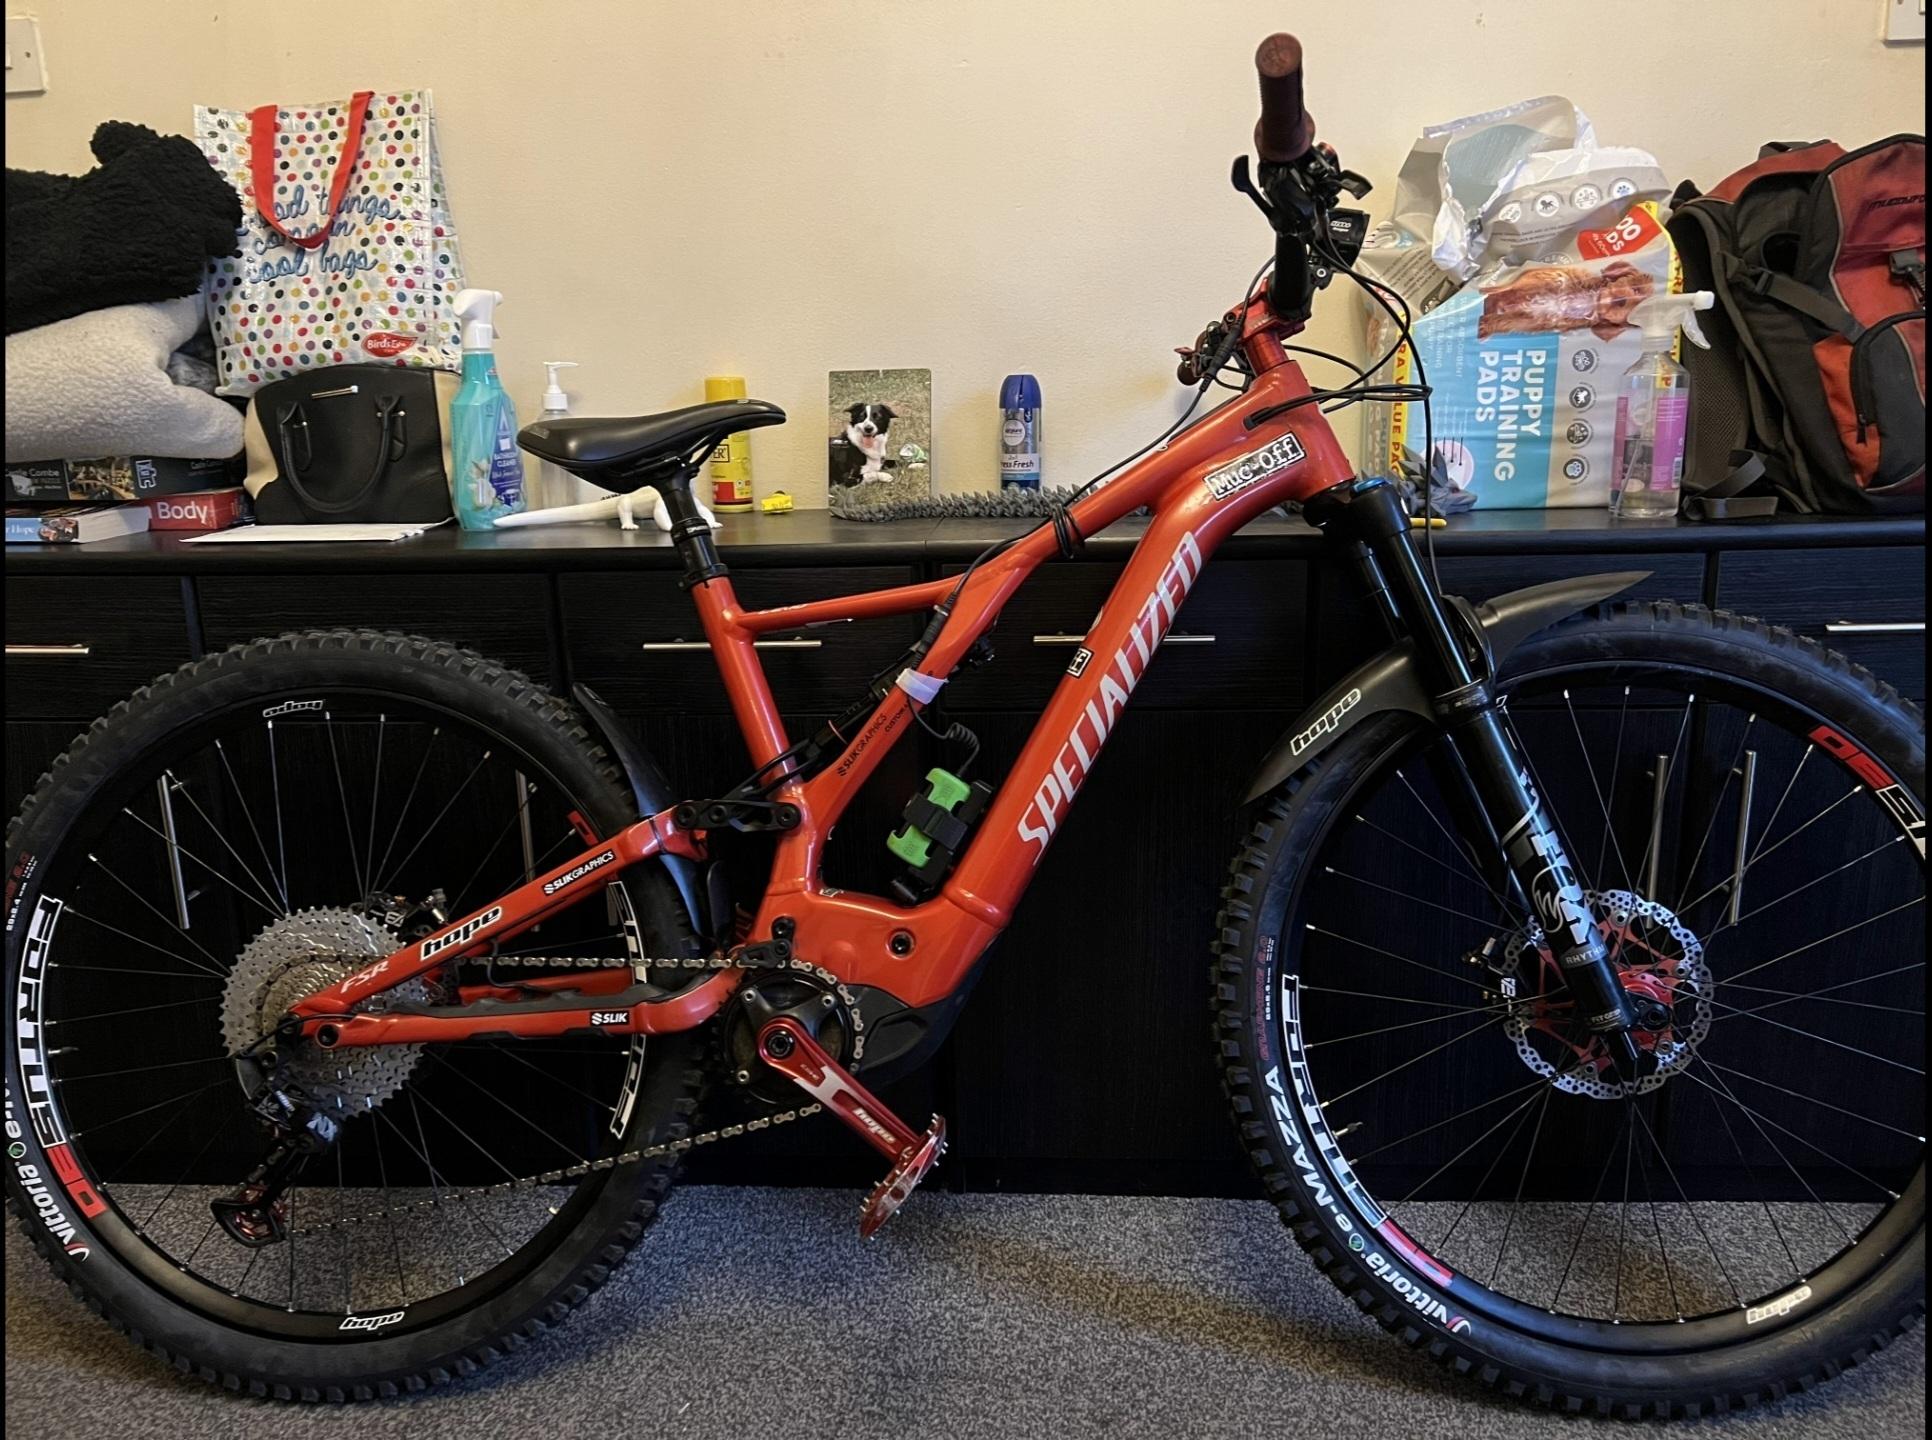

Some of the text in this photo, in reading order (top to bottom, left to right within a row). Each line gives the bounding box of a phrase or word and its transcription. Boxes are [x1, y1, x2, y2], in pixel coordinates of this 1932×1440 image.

[1475, 351, 1499, 422] PADS
[1493, 349, 1523, 481] TRAINING
[1520, 350, 1547, 437] PUPPY
[1211, 437, 1297, 494] Muc-Off
[156, 501, 208, 525] Body
[262, 700, 323, 717] hope
[1017, 531, 1202, 867] SPECIALIZED
[1290, 688, 1361, 756] hope
[552, 851, 614, 890] SLIKGRAPHICS
[420, 906, 502, 961] hope
[340, 960, 389, 994] FSR
[602, 1012, 627, 1024] SLIK
[17, 895, 107, 1219] FORTUS 30
[852, 1106, 896, 1145] hope
[1282, 973, 1388, 1229] FORTUS
[1265, 1064, 1355, 1234] e-MAZZA
[17, 1162, 78, 1246] vittoria
[339, 1311, 405, 1331] hope
[1363, 1252, 1456, 1329] vittoria
[1746, 1285, 1812, 1325] hope
